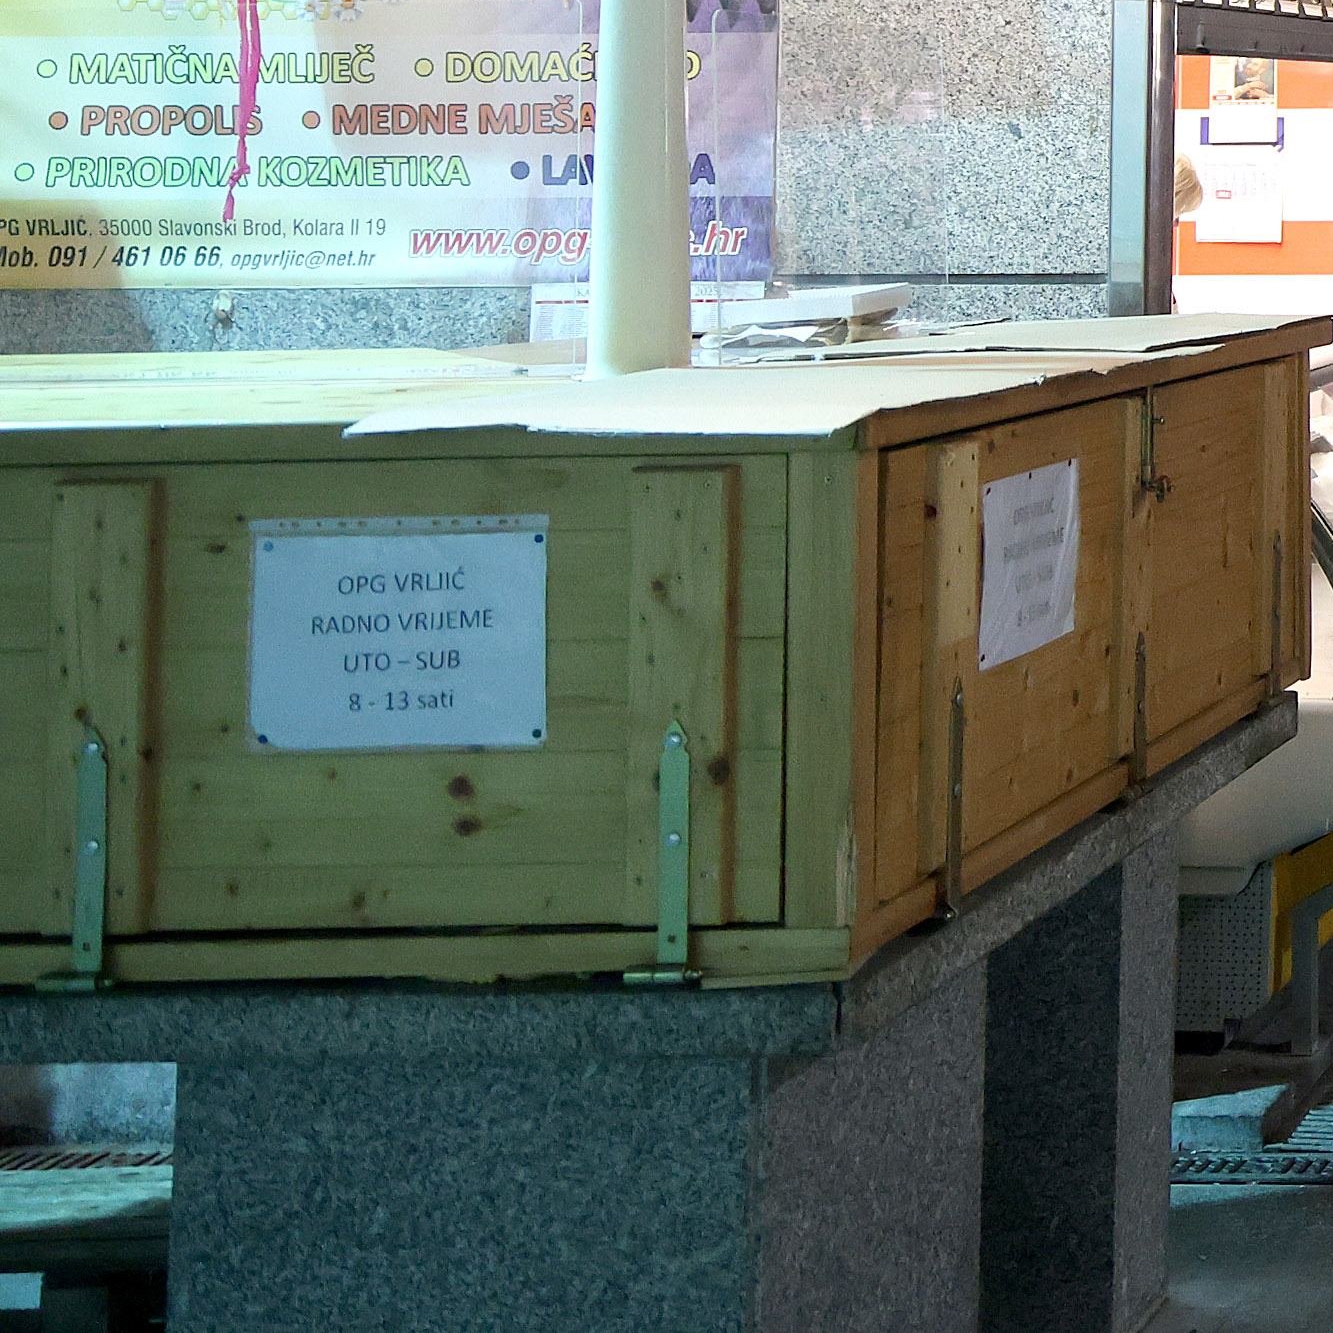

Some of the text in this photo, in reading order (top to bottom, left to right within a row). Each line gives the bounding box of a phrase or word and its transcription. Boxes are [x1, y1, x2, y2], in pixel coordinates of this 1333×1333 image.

[69, 44, 375, 84] MATIČNA MLIJEČ
[80, 104, 263, 136] PROPOLIS
[332, 95, 596, 136] MEDNE MJEŠA
[45, 155, 471, 188] PRIRODNA KOZMETIKA
[99, 219, 152, 236] 35000
[158, 218, 237, 236] Slavonski
[243, 218, 286, 238] Brod,
[293, 218, 344, 236] Kolara
[366, 218, 386, 236] 19
[48, 246, 87, 267] 091
[92, 245, 107, 269] /
[112, 246, 151, 267] 461
[160, 245, 186, 267] 06
[194, 245, 223, 269] 66,
[231, 250, 376, 270] opgvrljic@net.hr
[338, 567, 465, 595] OPG VRLJIĆ
[311, 609, 493, 636] RADNO VRIJEME
[343, 652, 391, 673] UTO
[416, 649, 460, 671] SUB
[349, 692, 361, 712] 8
[385, 690, 409, 711] 13
[417, 689, 454, 710] sati
